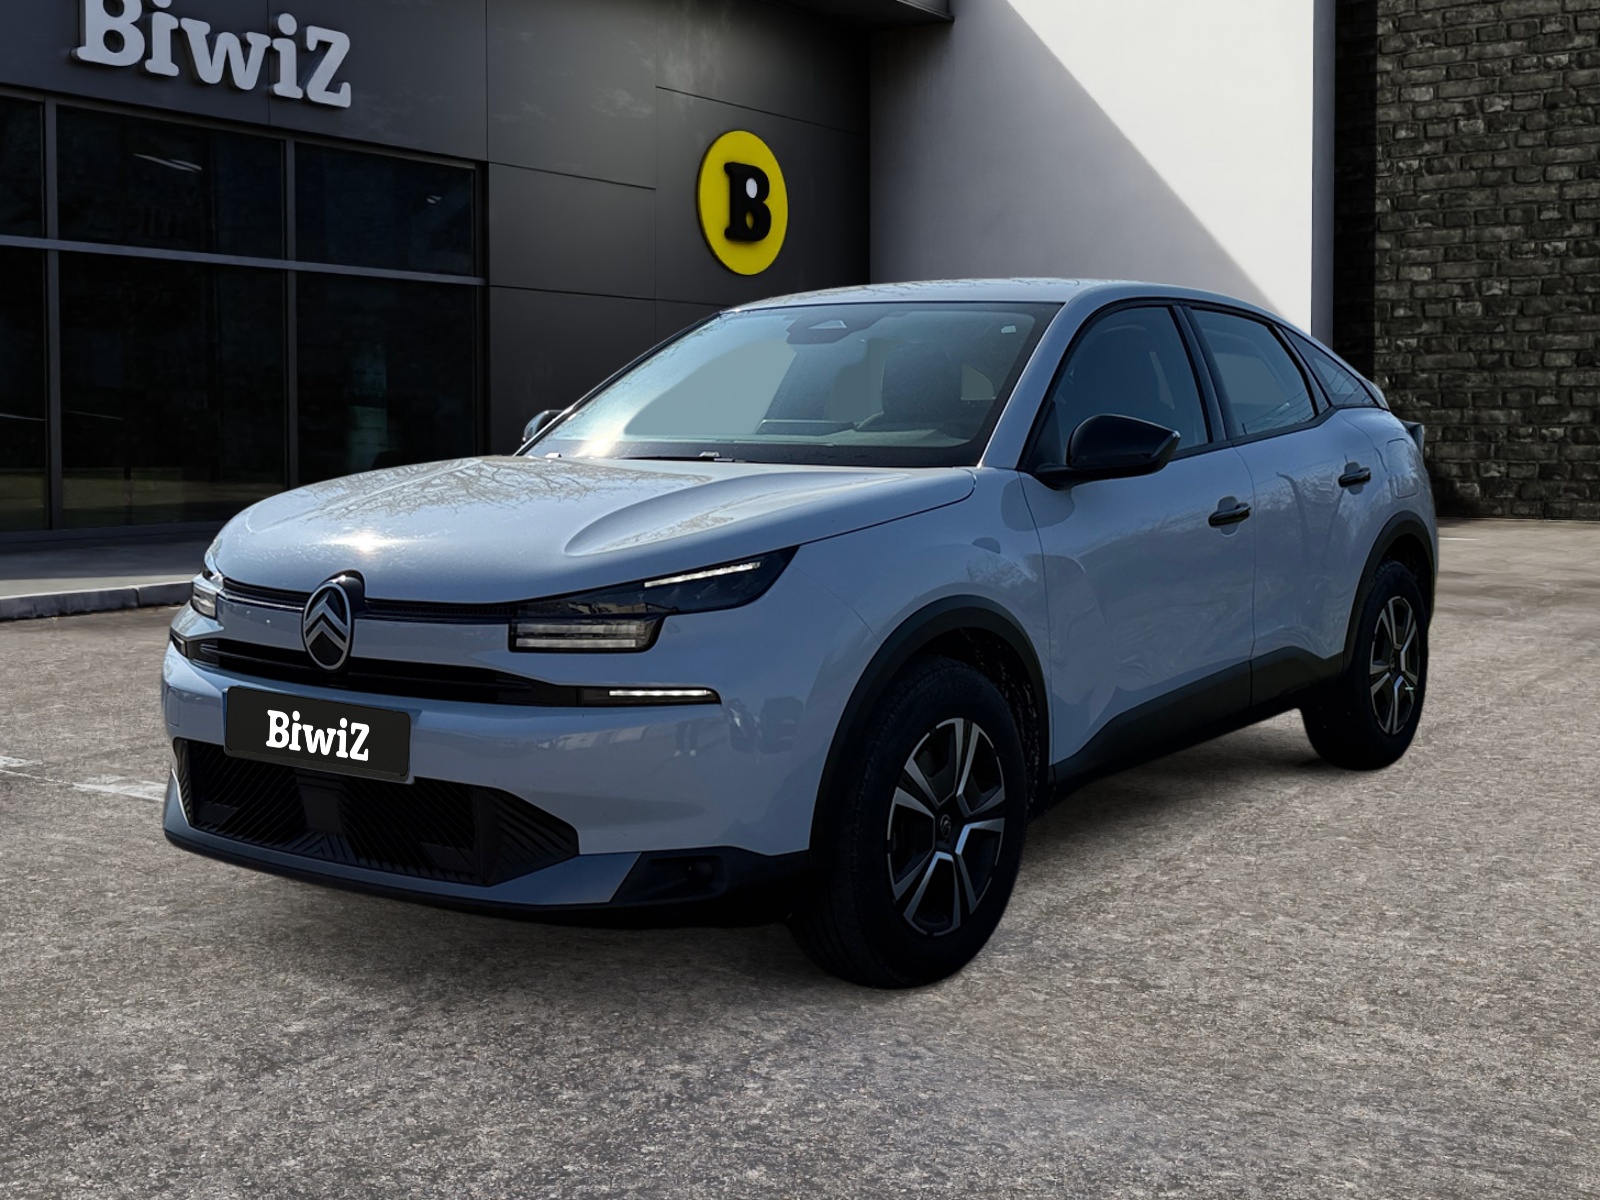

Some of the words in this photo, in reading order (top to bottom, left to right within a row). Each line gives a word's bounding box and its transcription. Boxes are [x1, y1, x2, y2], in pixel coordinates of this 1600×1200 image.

[75, 0, 351, 108] BiwiZ
[724, 162, 771, 242] B
[266, 710, 369, 761] BiwiZ
